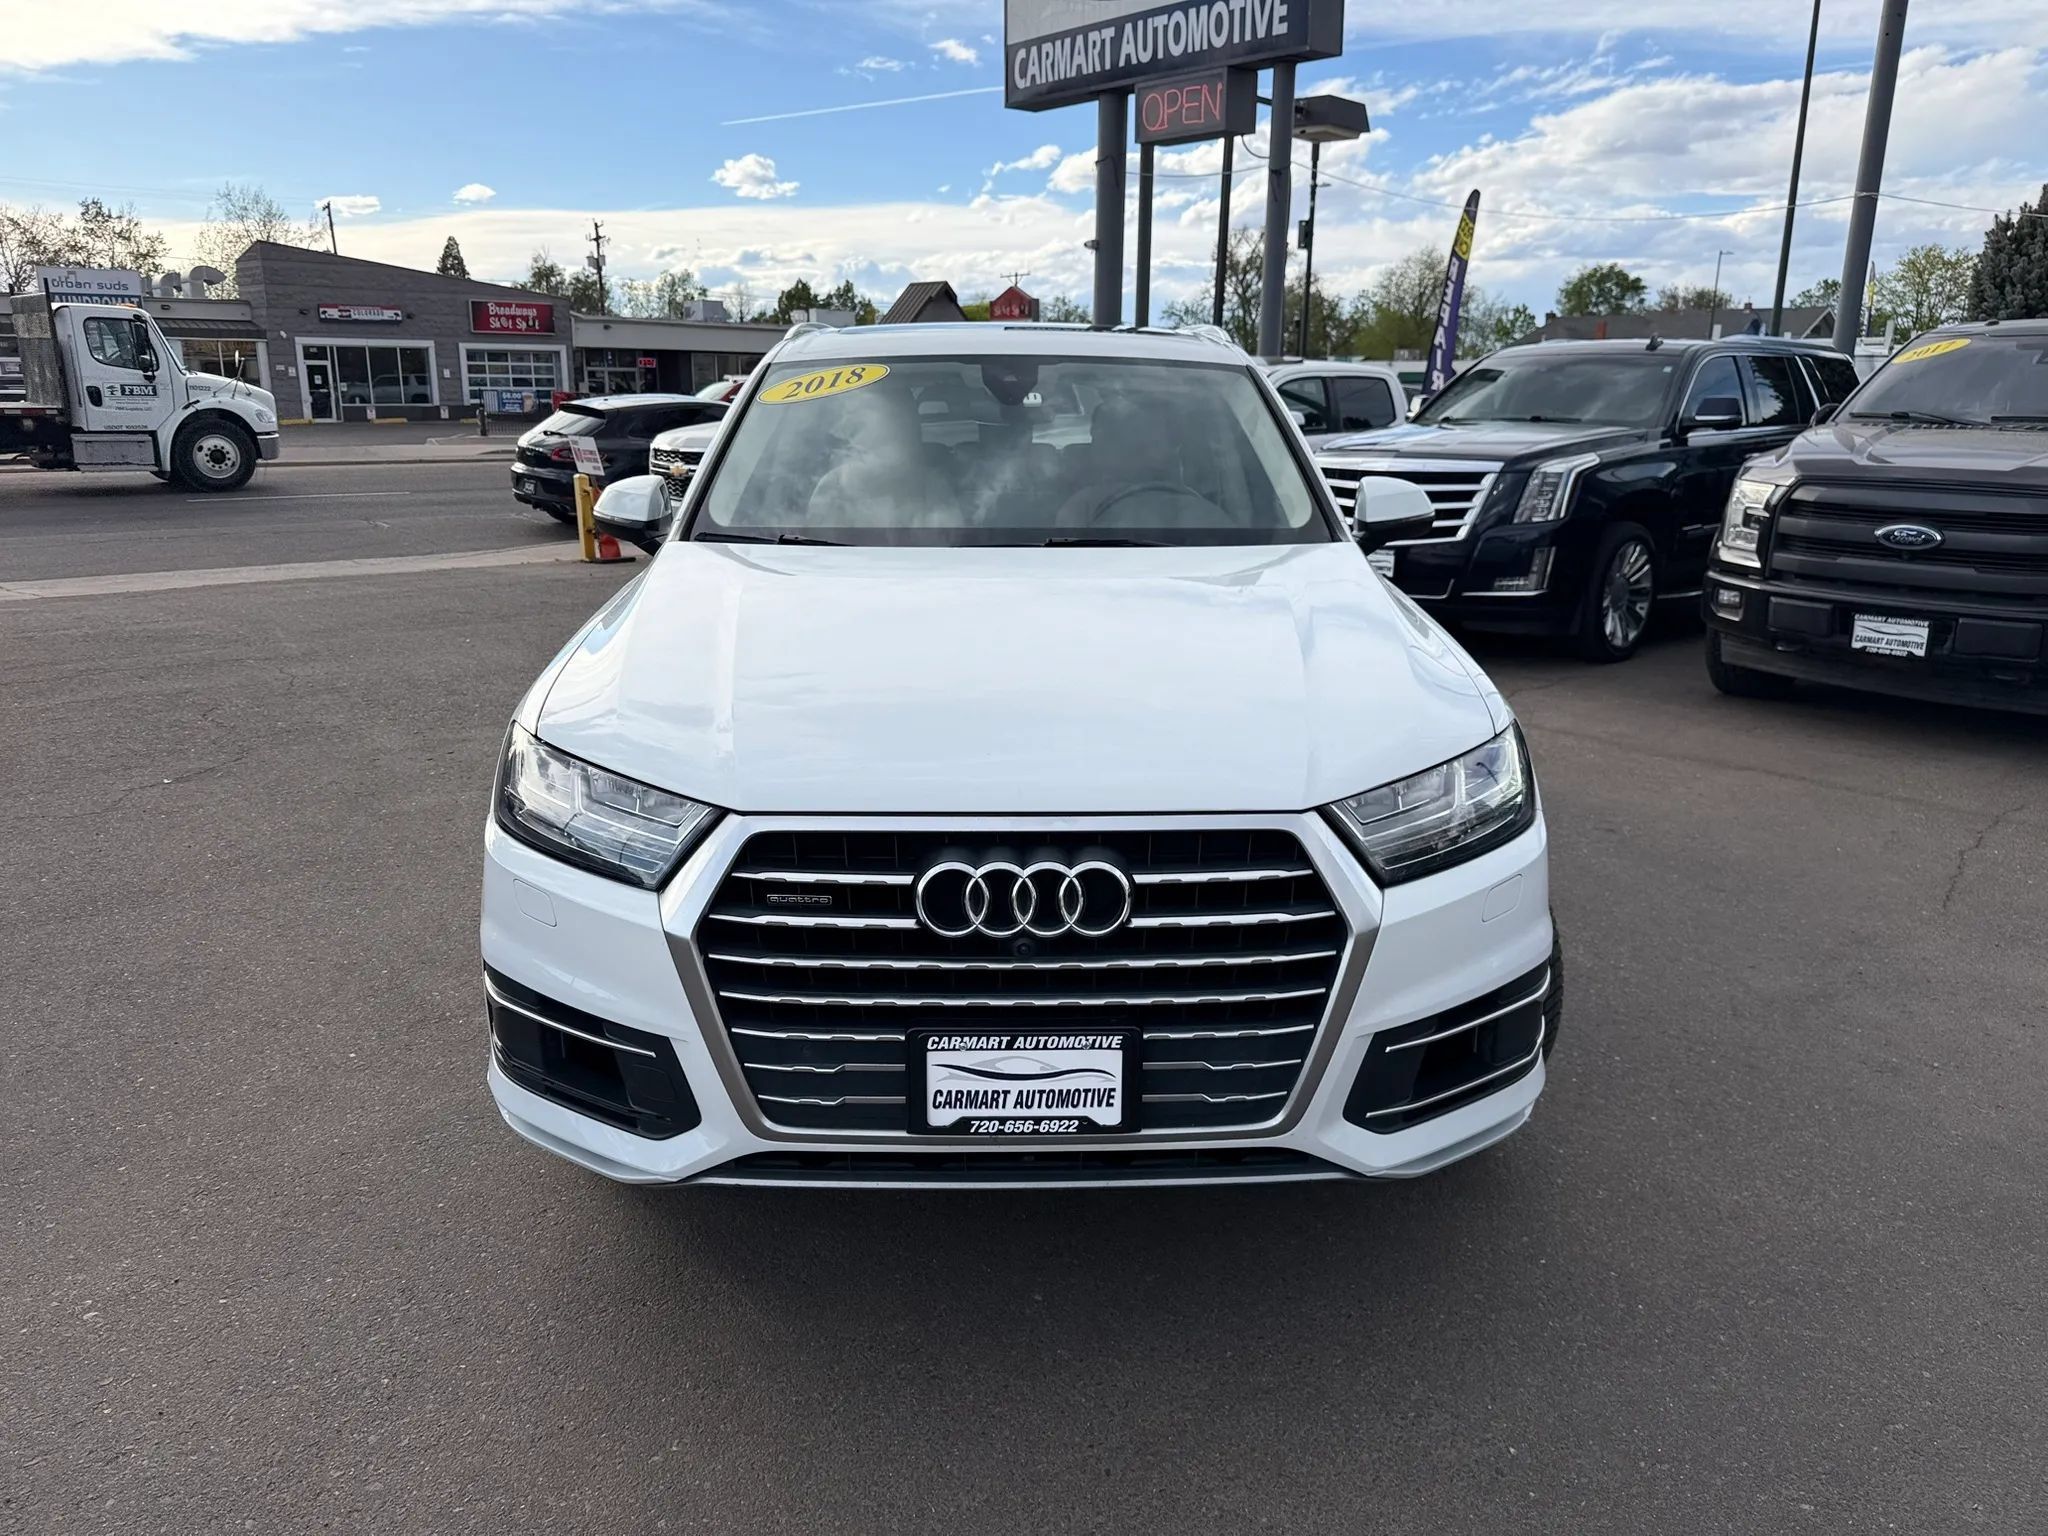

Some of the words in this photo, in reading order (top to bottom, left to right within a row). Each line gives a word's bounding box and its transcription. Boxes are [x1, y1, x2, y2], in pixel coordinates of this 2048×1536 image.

[1013, 26, 1115, 89] CARMART
[1118, 0, 1289, 68] AUTOMOTIVE
[1142, 82, 1225, 131] OPEN
[97, 281, 129, 291] suds
[123, 385, 154, 395] FBM
[781, 367, 866, 400] 2018
[1855, 634, 1885, 645] CARMART
[927, 1036, 1011, 1050] CARMART
[1012, 1035, 1123, 1049] AUTOMOTIVE
[932, 1088, 1011, 1110] CARMART
[1013, 1087, 1117, 1110] AUTOMOTIVE
[969, 1119, 1079, 1134] 720-656-6922
